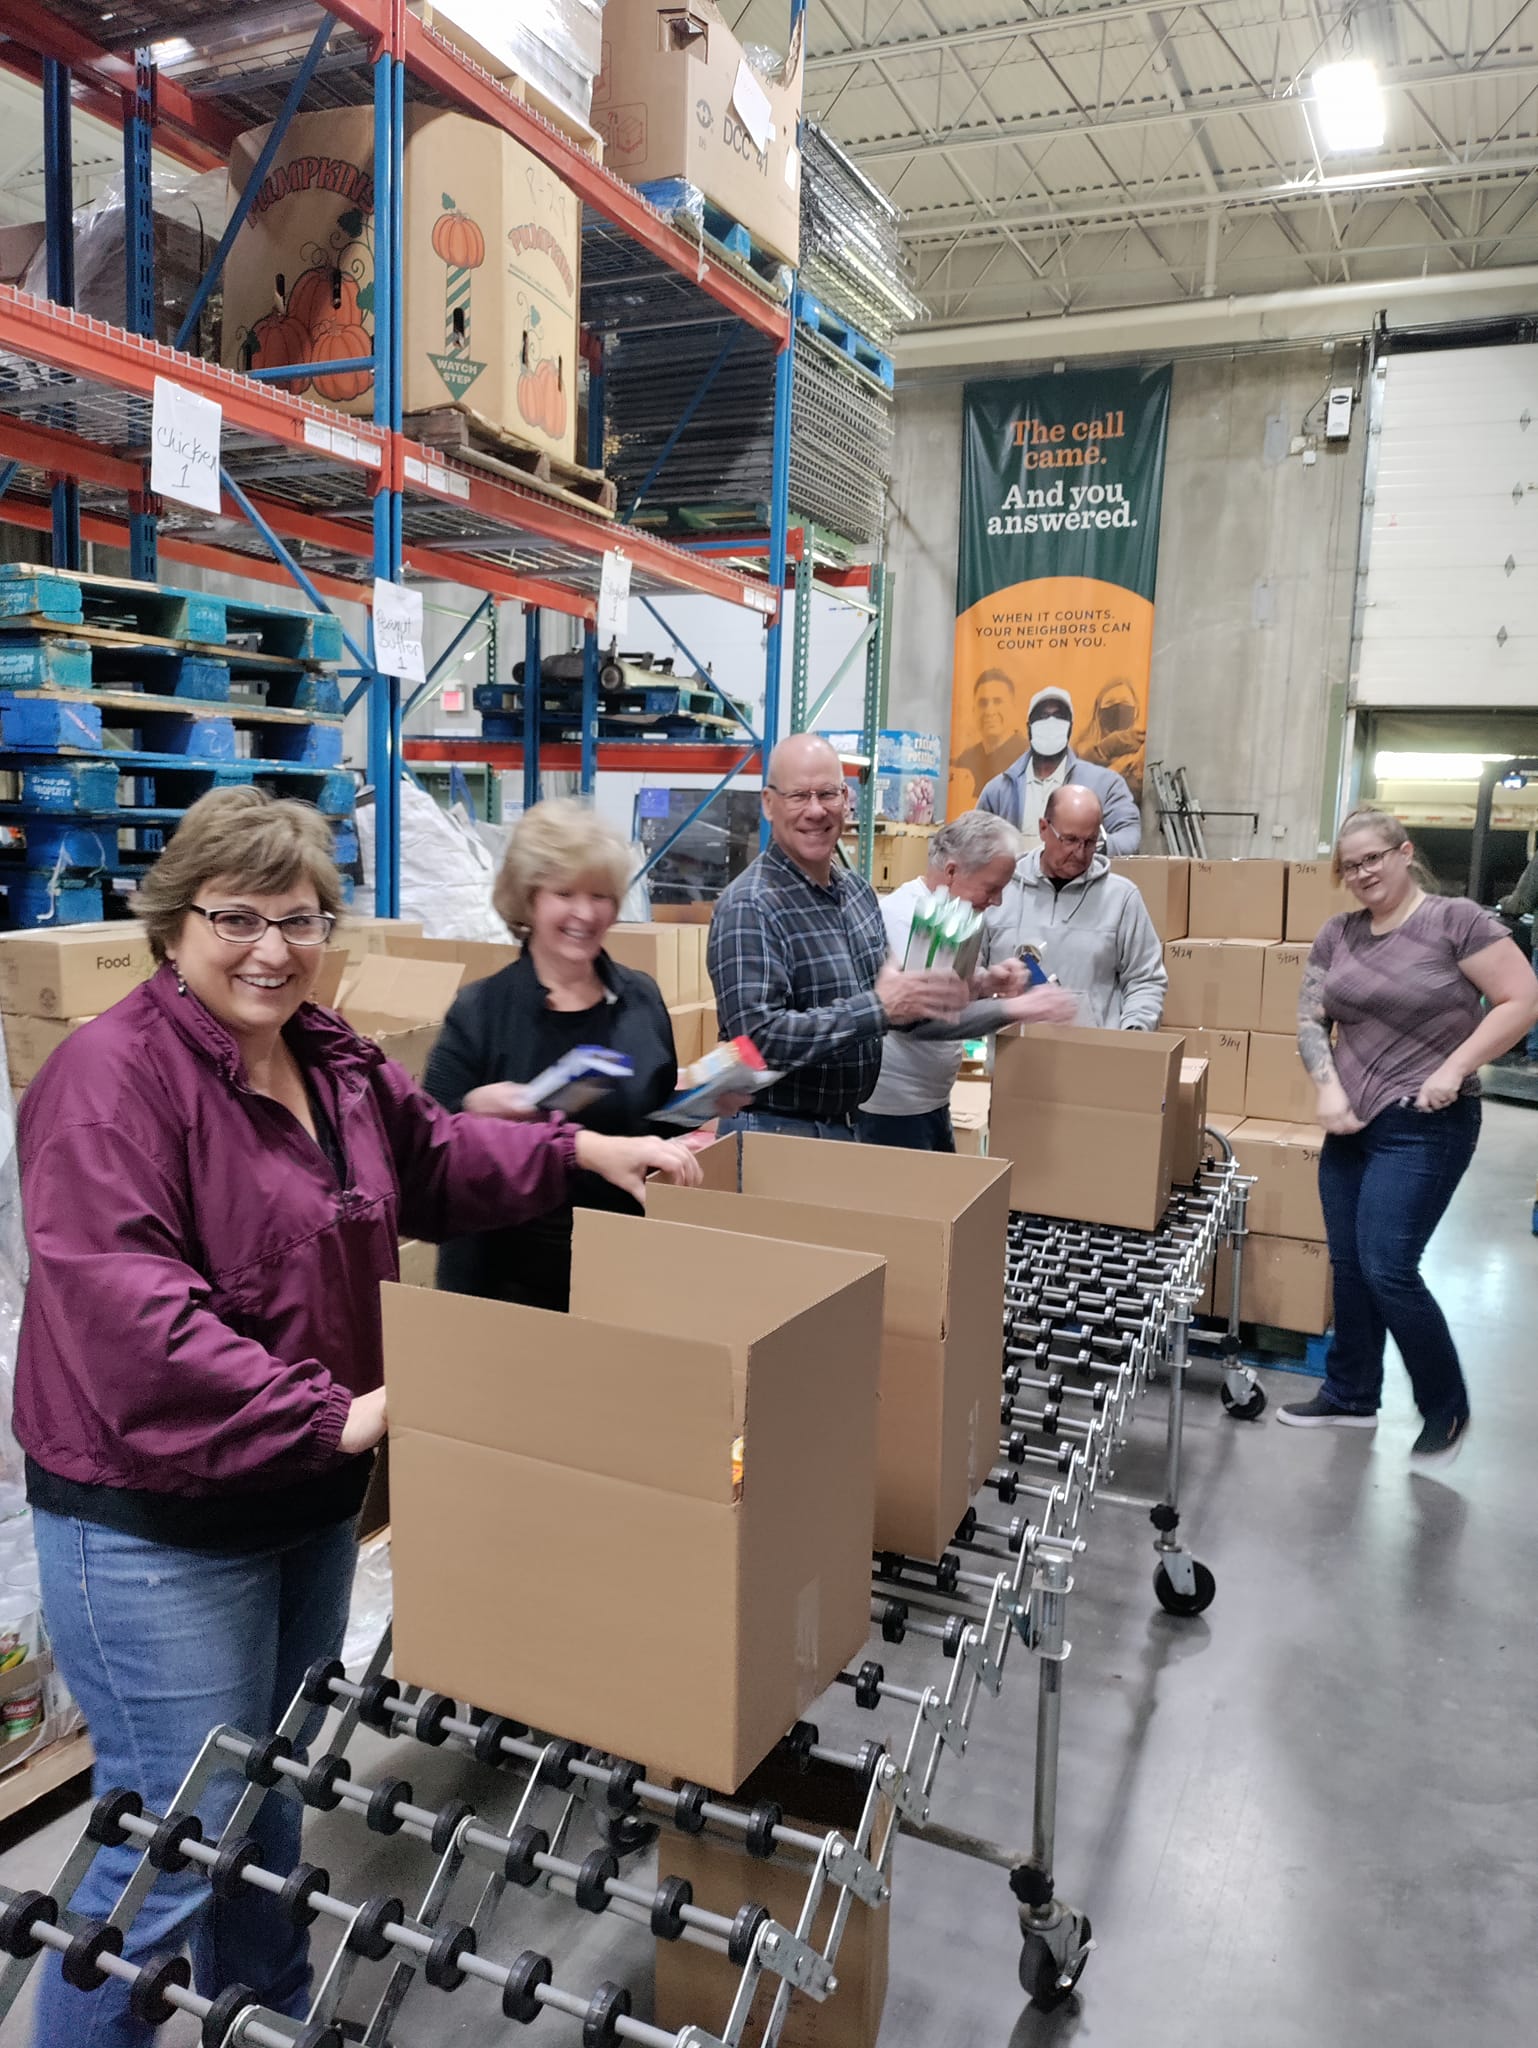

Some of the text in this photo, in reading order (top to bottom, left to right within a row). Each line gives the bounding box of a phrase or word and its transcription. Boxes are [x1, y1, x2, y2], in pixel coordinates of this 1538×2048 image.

[723, 115, 751, 161] DCC
[436, 359, 478, 375] WATCH
[442, 372, 471, 385] STEP
[1010, 410, 1125, 447] The call
[1023, 445, 1108, 470] came.
[171, 463, 191, 488] 1
[1001, 480, 1125, 511] And you
[987, 501, 1138, 535] answered.
[992, 612, 1033, 624] WHEN
[1038, 611, 1050, 623] IT
[975, 622, 1131, 638] YOUR NEIGHBORS CAN
[997, 636, 1107, 650] COUNT ON YOU.
[96, 954, 131, 970] Food
